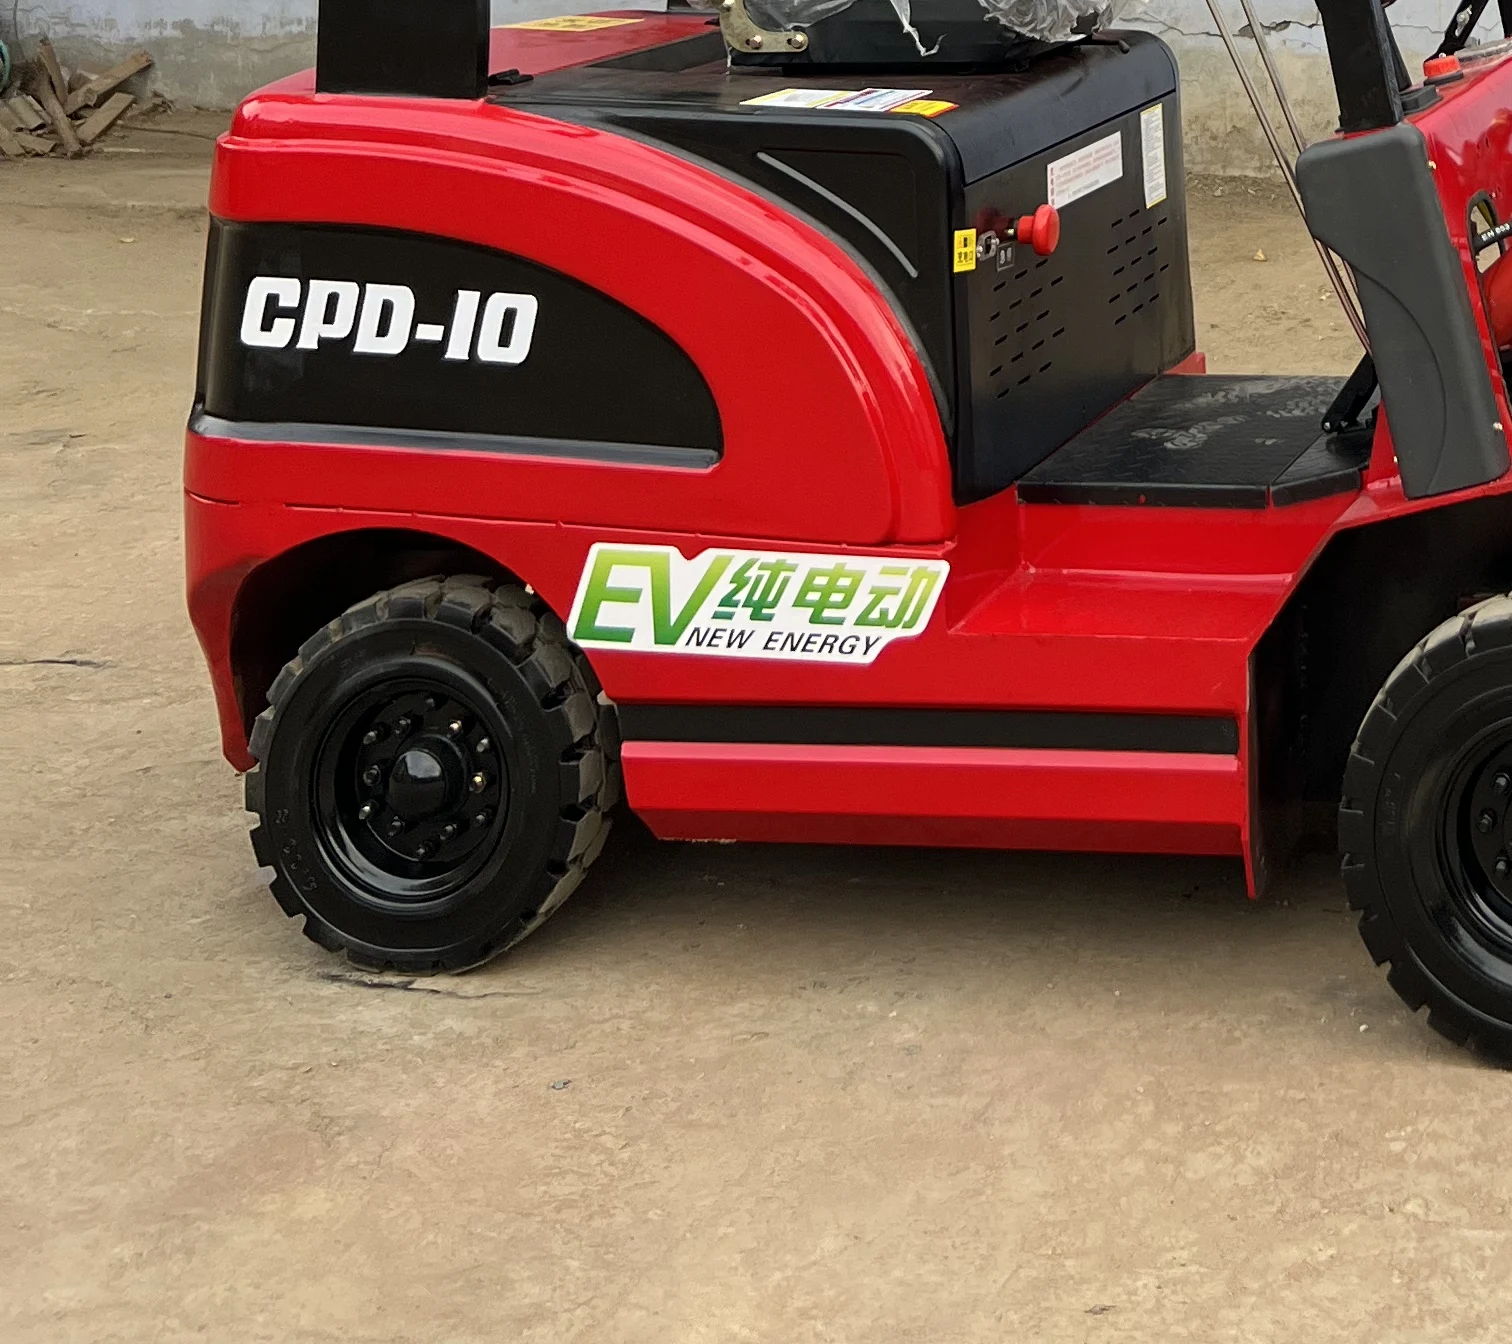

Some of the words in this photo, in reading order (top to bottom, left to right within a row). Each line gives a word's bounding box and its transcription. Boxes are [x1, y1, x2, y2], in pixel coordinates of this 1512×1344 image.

[240, 276, 539, 365] CPD-10
[573, 548, 735, 646] EV
[711, 558, 942, 629] 纯电动
[684, 627, 755, 650] NEW
[763, 631, 881, 656] ENERGY
